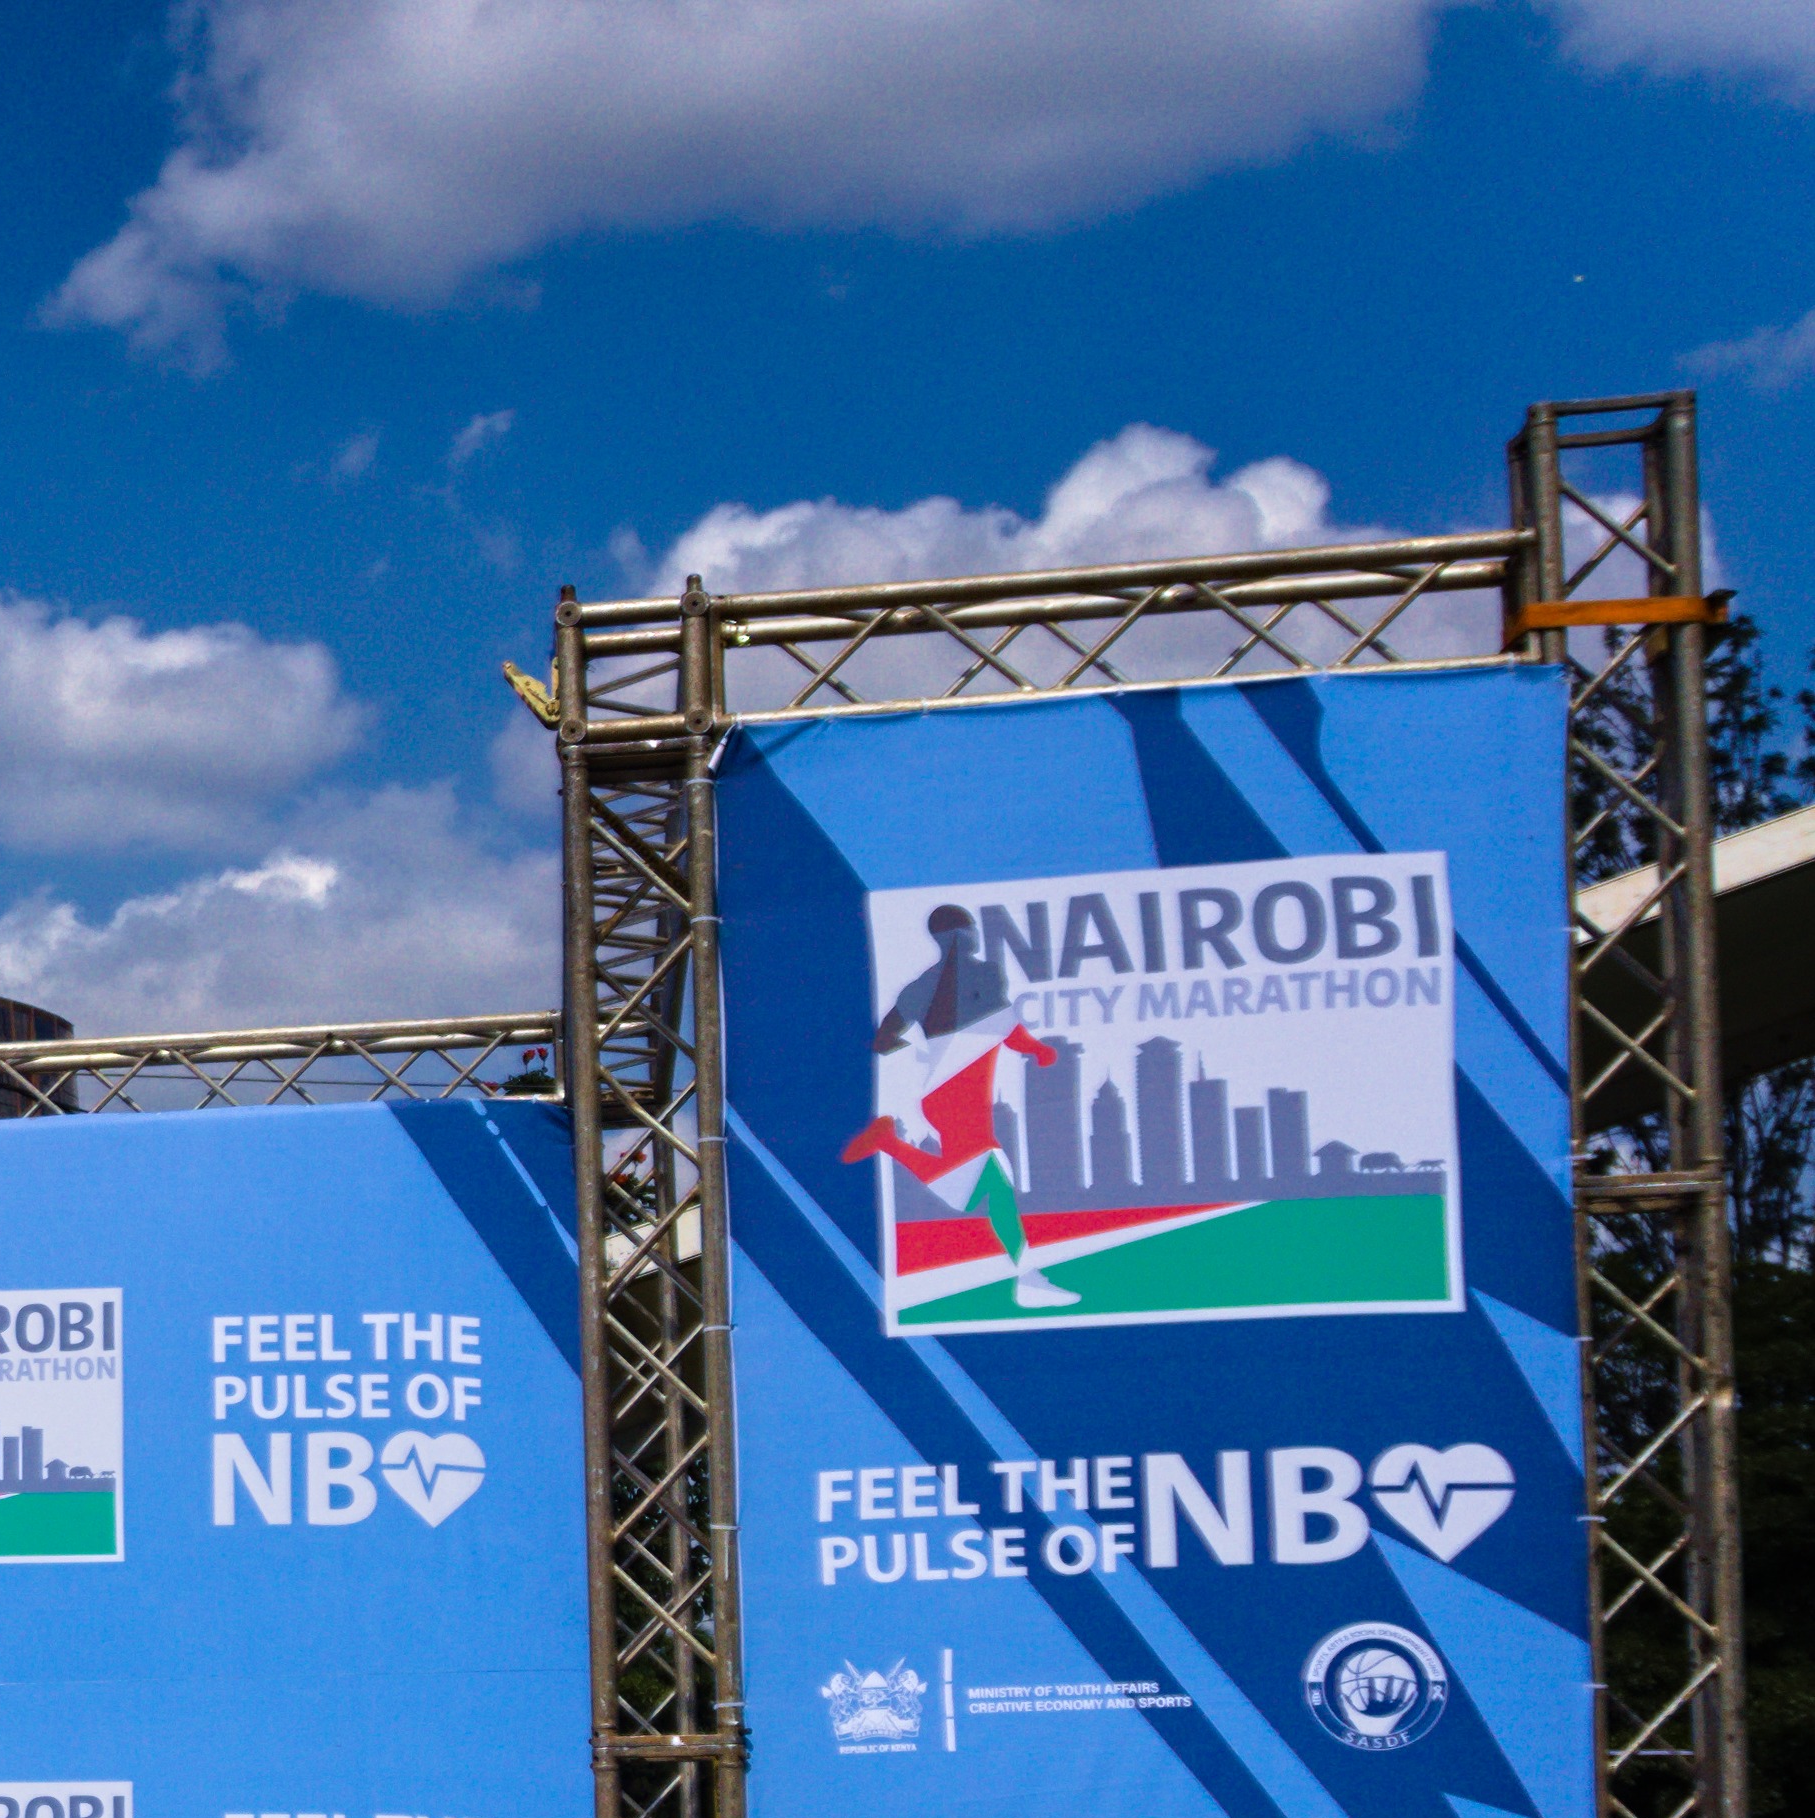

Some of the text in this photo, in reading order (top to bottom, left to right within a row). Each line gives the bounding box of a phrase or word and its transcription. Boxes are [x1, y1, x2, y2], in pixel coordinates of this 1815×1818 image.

[979, 874, 1442, 984] NAIROBI
[1013, 967, 1442, 1031] CITY MARATHON
[213, 1313, 481, 1365] FEEL THE
[214, 1373, 481, 1421] PULSE OF
[817, 1457, 1133, 1523] FEEL THE
[821, 1524, 1136, 1586] PULSE OF
[969, 1682, 1160, 1699] MINISTRY OF YOUTH AFFAIRS
[969, 1696, 1192, 1714] CREATIVE ECONOMY AND SPORTS
[1344, 1731, 1410, 1748] SASDF
